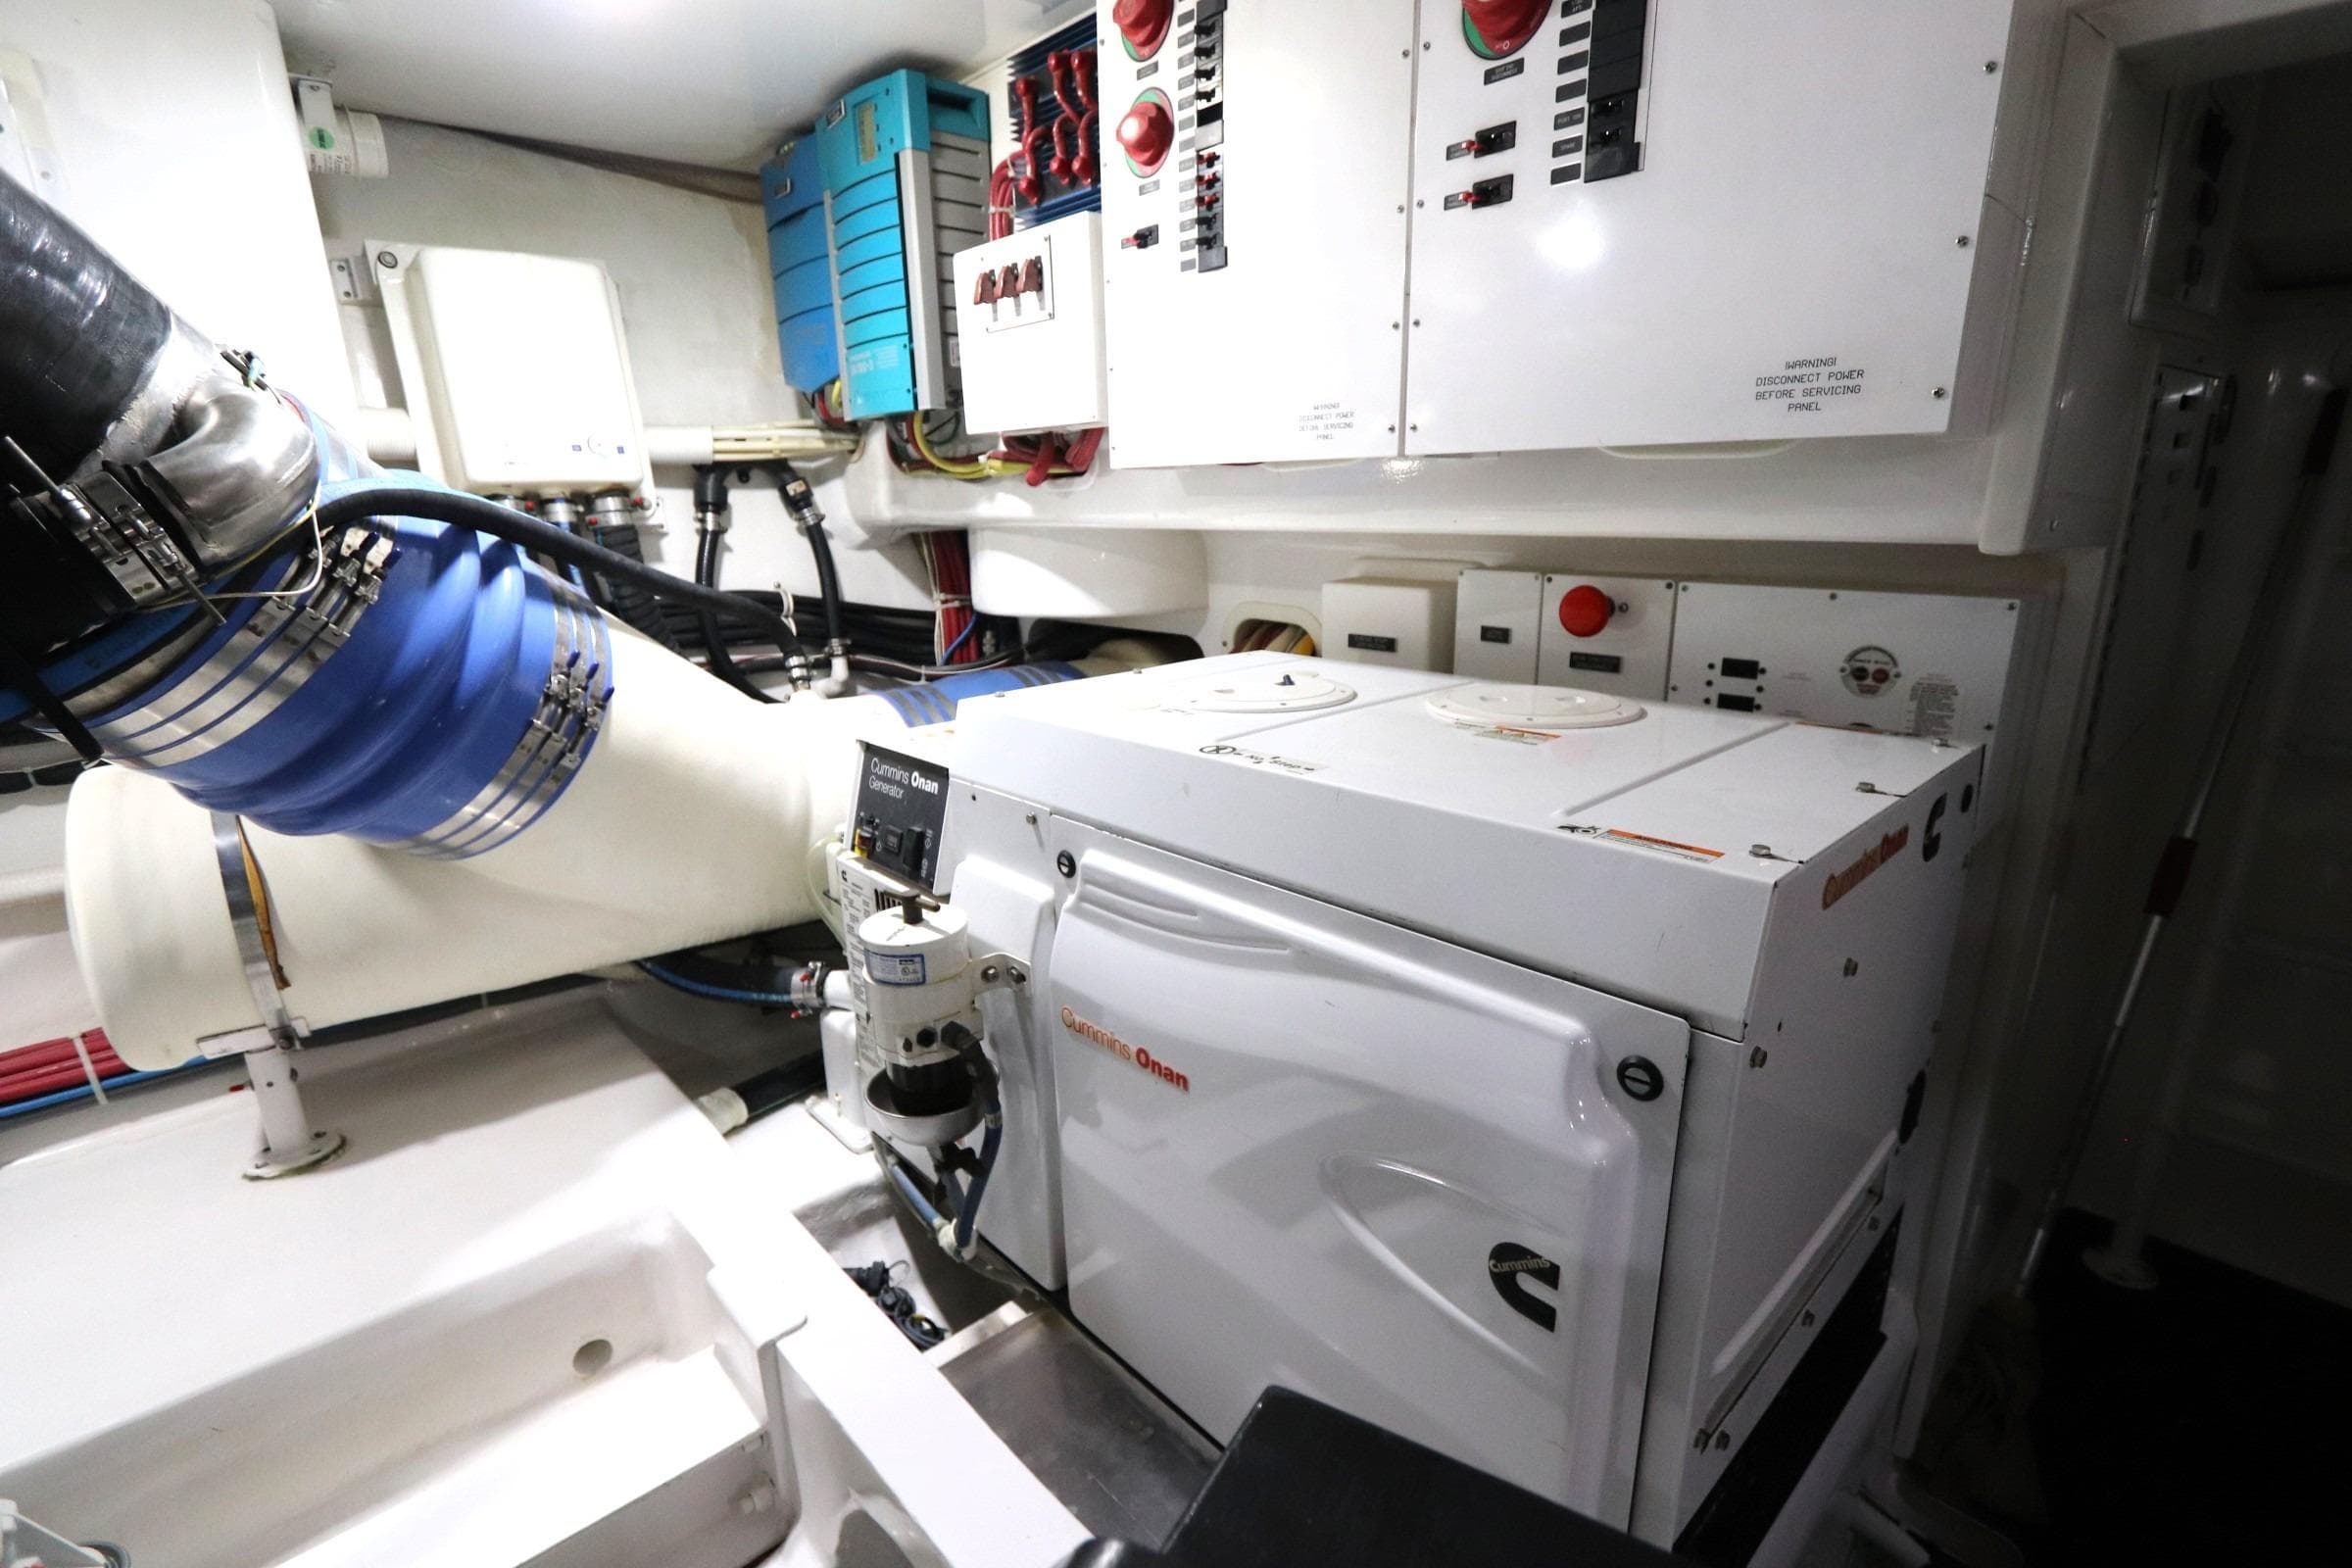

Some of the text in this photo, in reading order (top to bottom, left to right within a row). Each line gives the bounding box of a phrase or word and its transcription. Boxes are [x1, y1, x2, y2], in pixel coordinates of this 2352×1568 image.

[1755, 368, 1865, 387] DISCONNECT POWER
[1755, 384, 1862, 401] BEFORE SERVICING
[1788, 402, 1822, 413] PANEL
[870, 757, 939, 795] Cummins Onan
[868, 775, 905, 799] Generator
[1060, 1006, 1190, 1093] Cummins Onan
[1489, 1255, 1551, 1273] Cummins
